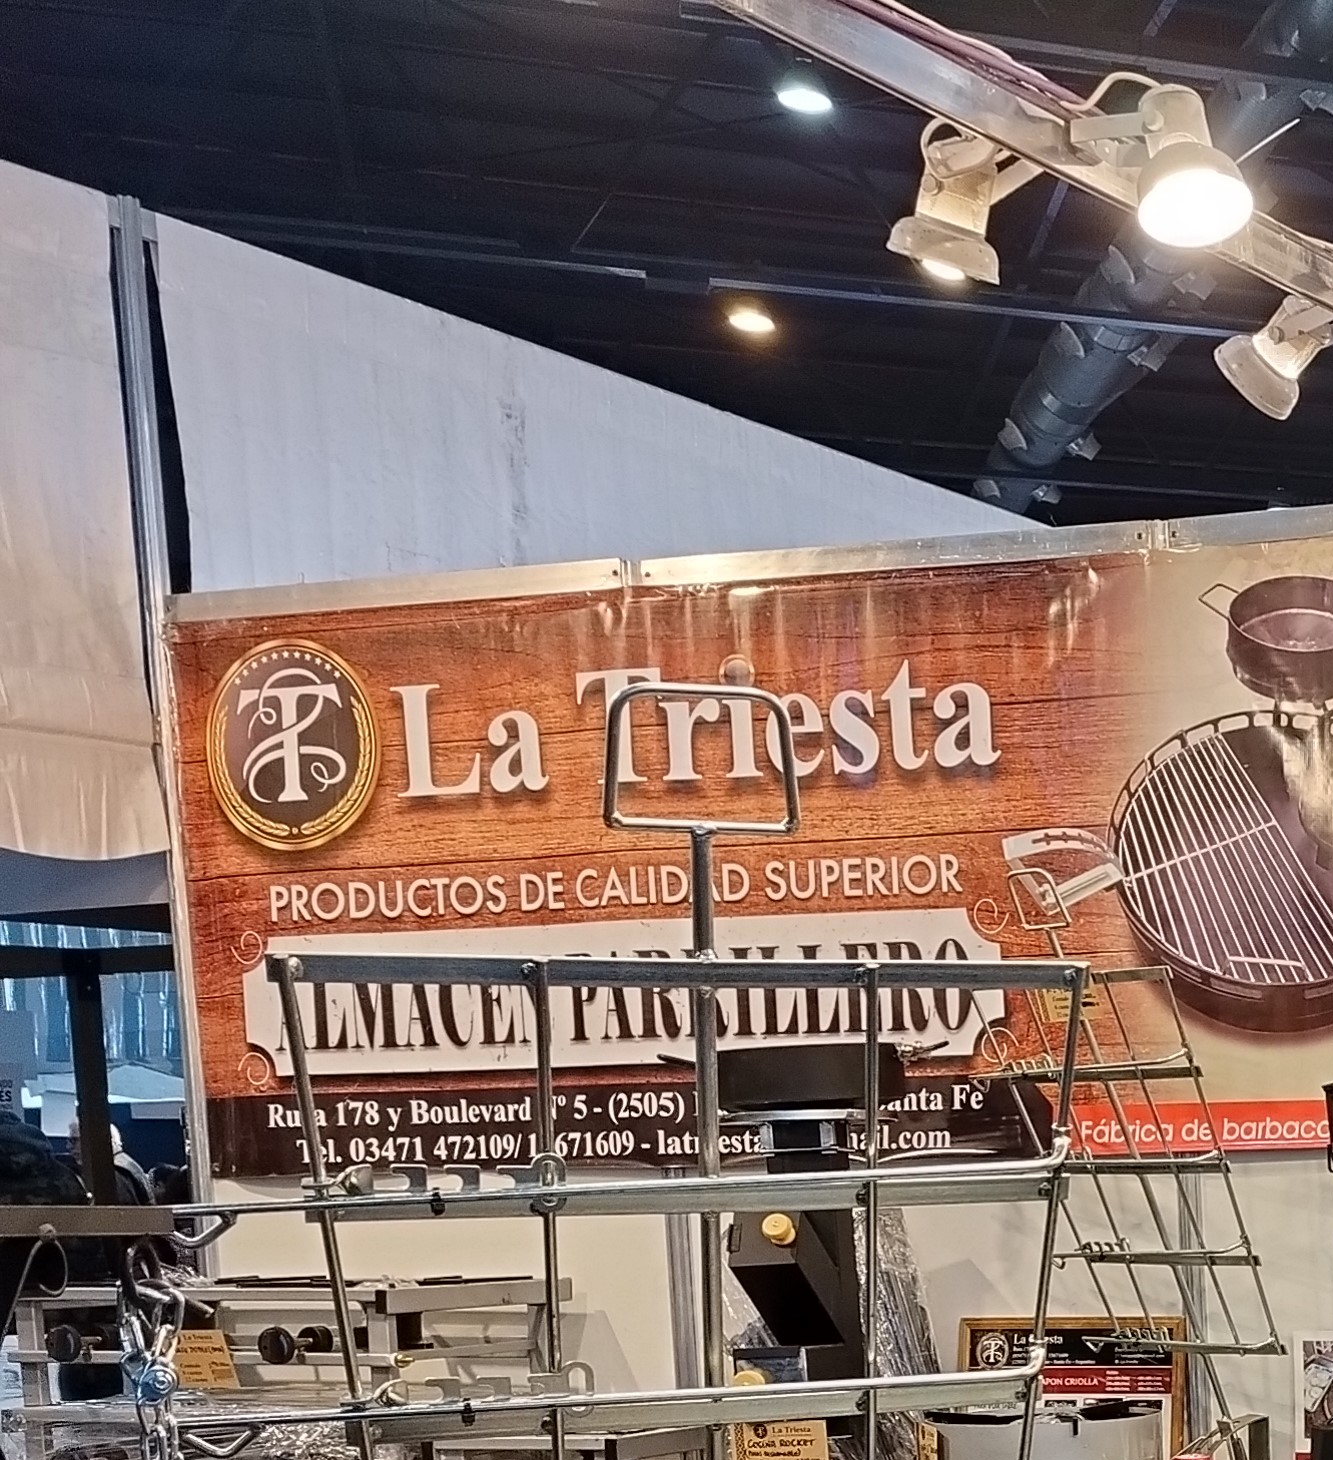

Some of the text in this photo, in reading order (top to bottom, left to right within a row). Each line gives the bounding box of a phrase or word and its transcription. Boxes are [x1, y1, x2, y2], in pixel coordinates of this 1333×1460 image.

[389, 657, 1002, 799] La Triesta
[269, 853, 963, 923] PRODUCTOS DE CALIDD SUPERIOR
[267, 1102, 326, 1129] Rua
[336, 1099, 380, 1127] 178
[387, 1106, 403, 1132] y
[410, 1096, 532, 1125] Boulevard
[573, 1094, 588, 1120] 5
[608, 1090, 685, 1125] (2505)
[878, 1087, 944, 1112] anta
[951, 1084, 984, 1110] Fe
[1081, 1111, 1173, 1143] Fábrica
[1181, 1118, 1212, 1142] de
[350, 1135, 424, 1162] 03471
[1041, 1377, 1063, 1386] APON
[1064, 1378, 1099, 1386] CRIOLLA
